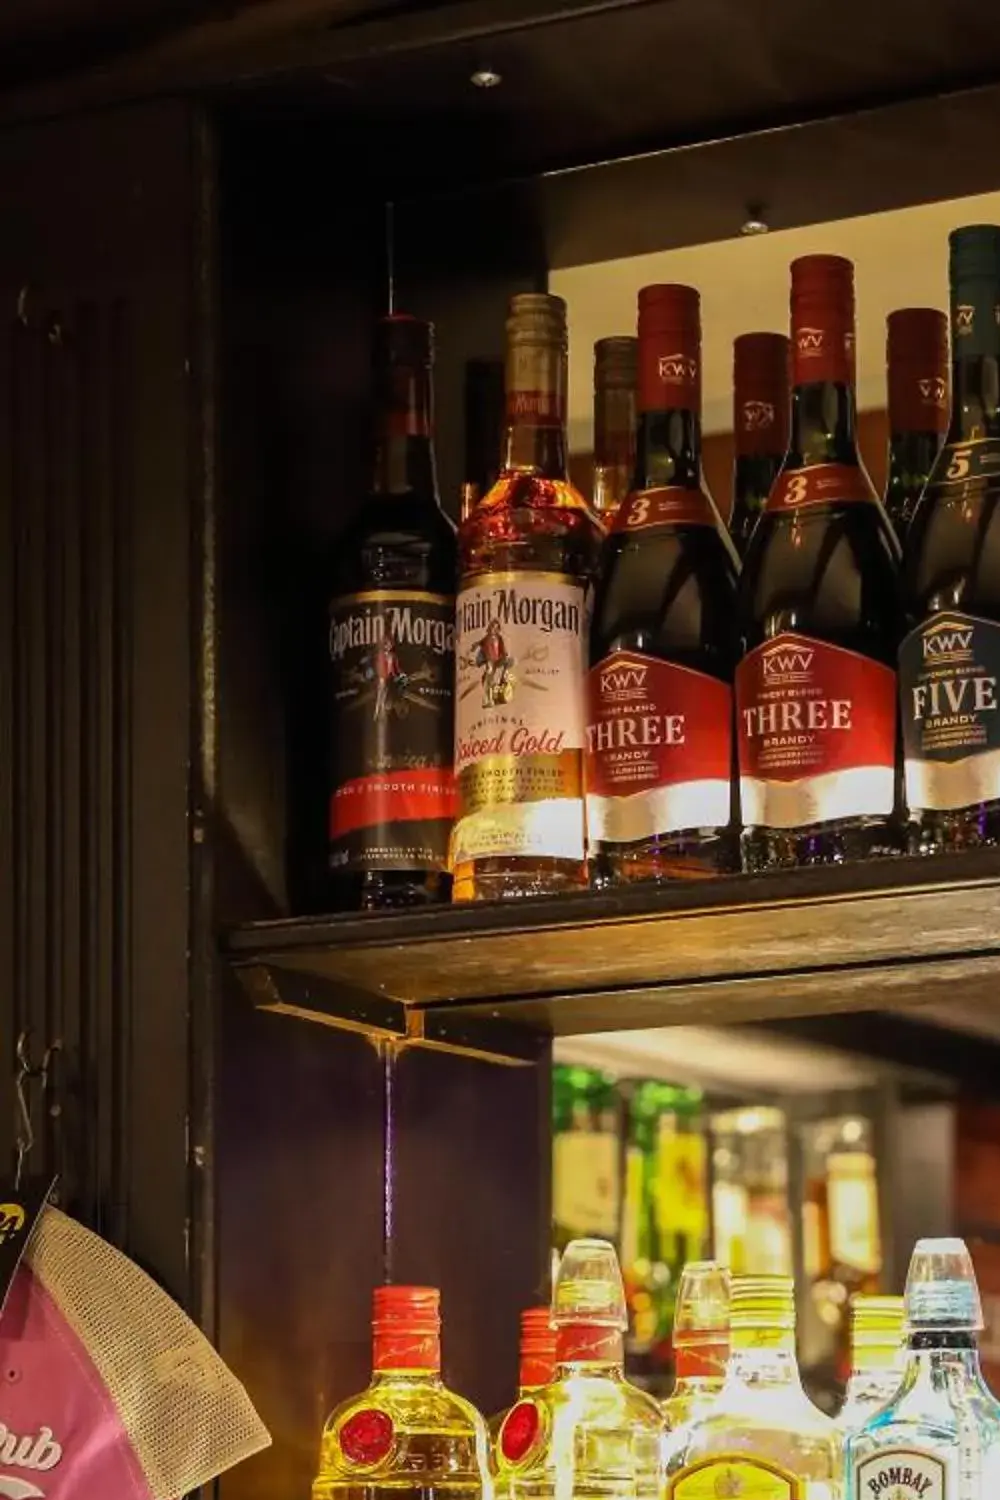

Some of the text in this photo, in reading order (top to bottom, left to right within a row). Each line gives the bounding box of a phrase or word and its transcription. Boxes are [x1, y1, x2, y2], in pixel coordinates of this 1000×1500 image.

[947, 450, 973, 479] 5
[784, 475, 808, 504] 3
[628, 498, 652, 526] 3
[492, 588, 579, 636] Morgan
[923, 631, 973, 658] KWV
[762, 653, 814, 675] KWV
[600, 670, 647, 692] KWV
[912, 677, 998, 721] FIVE
[743, 699, 853, 737] THREE
[925, 714, 977, 729] BRANDY
[510, 727, 565, 757] Gold
[585, 715, 685, 753] THREE
[0, 1423, 62, 1471] ub
[867, 1467, 934, 1500] BOMBAY
